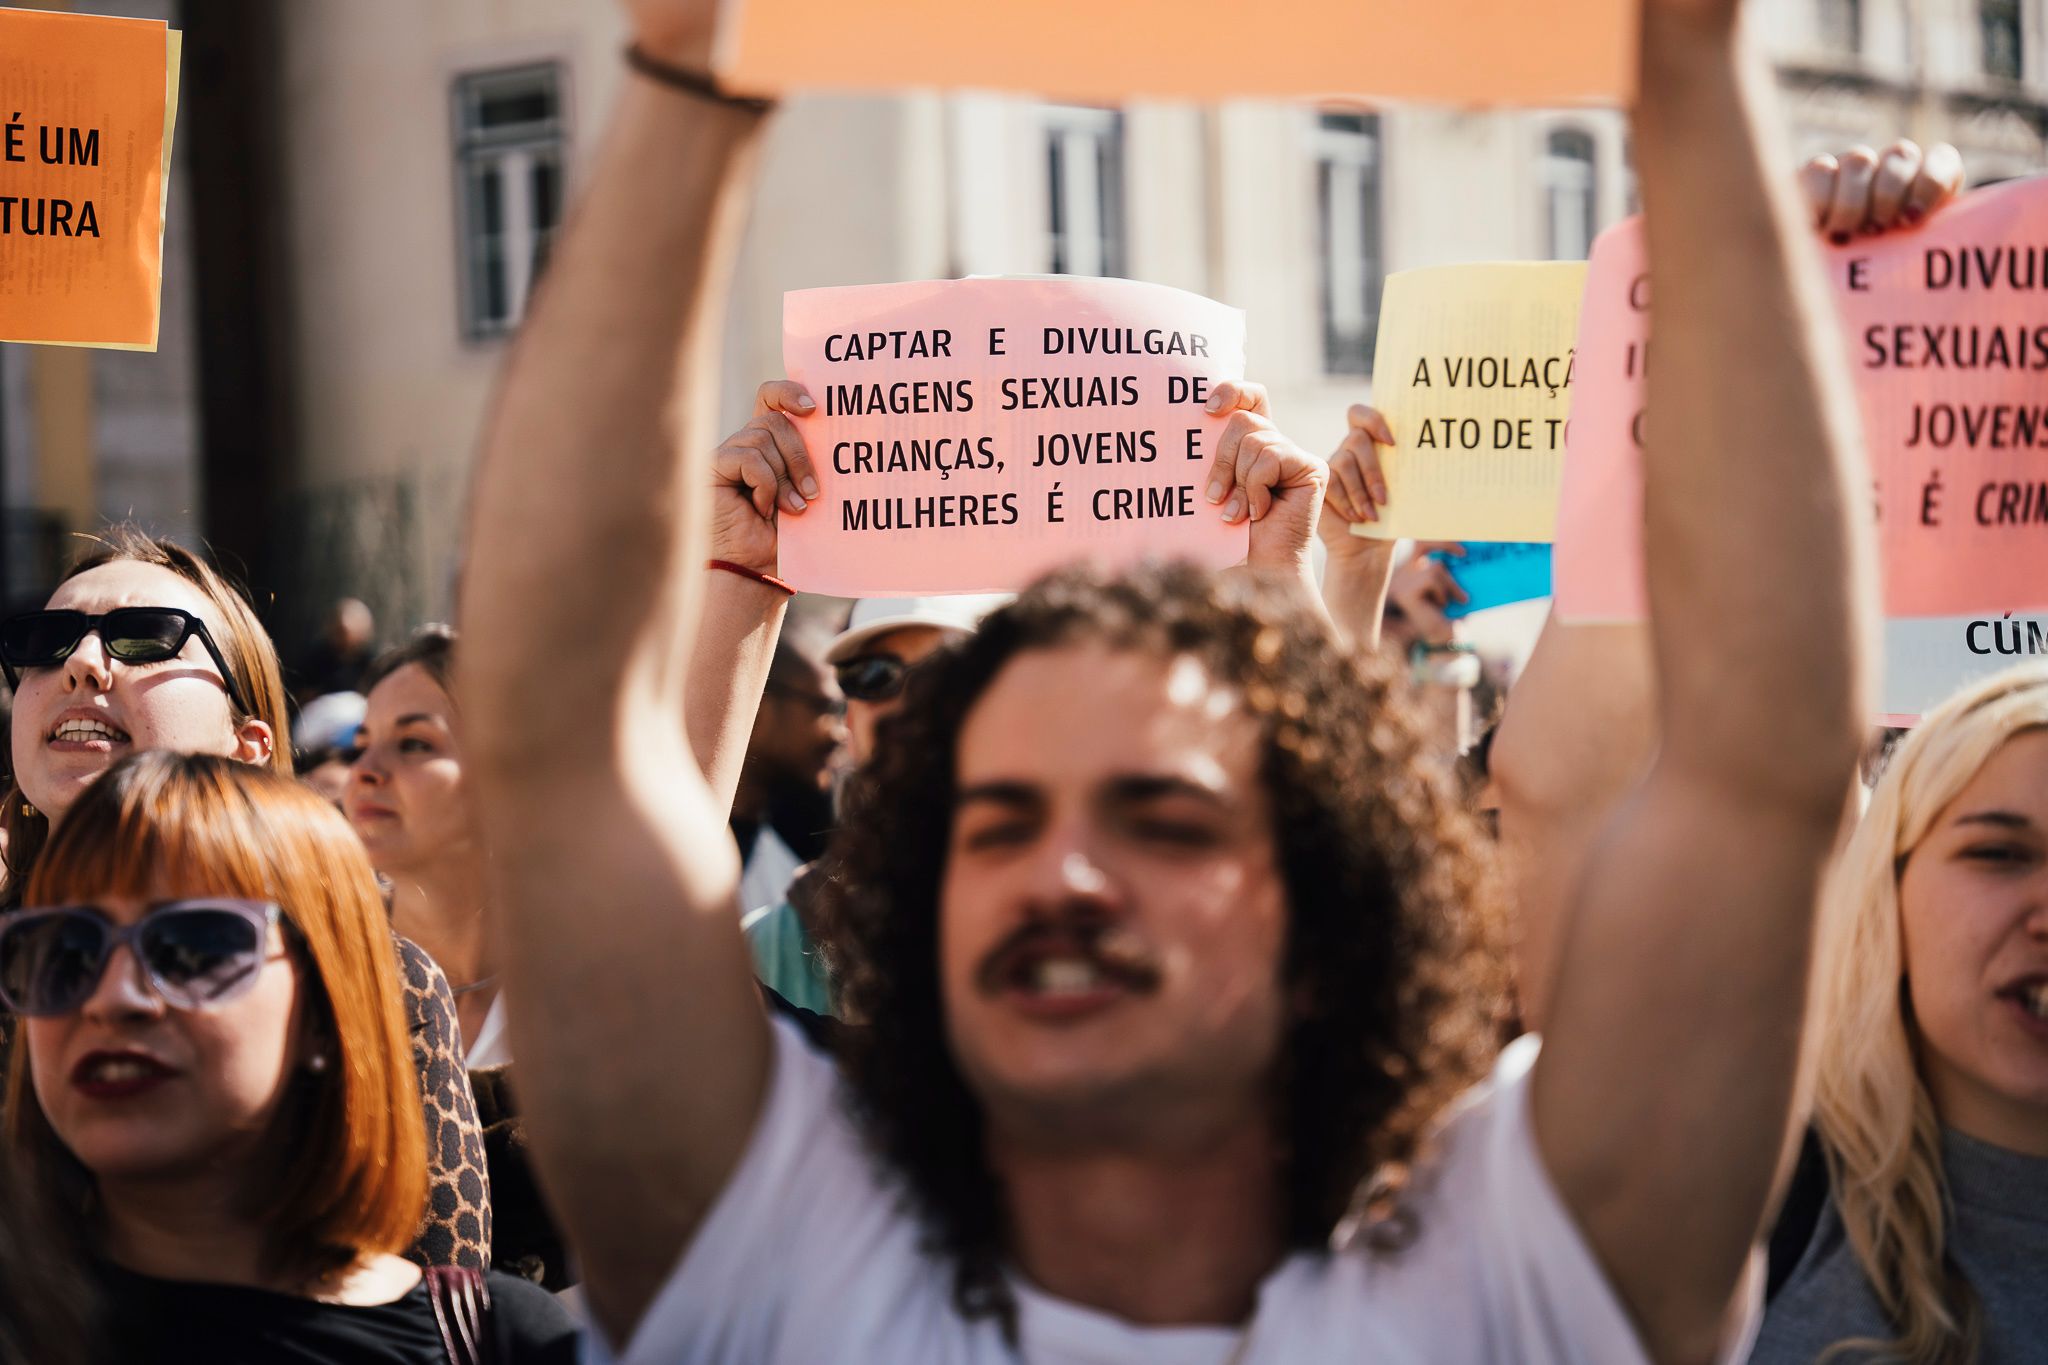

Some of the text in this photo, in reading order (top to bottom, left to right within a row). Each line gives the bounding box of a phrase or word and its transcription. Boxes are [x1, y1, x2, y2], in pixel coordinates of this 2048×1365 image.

[5, 112, 99, 166] É UM
[1848, 258, 1871, 291] E
[825, 327, 1209, 362] CAPTAR E DIVULGAR
[1413, 358, 1431, 387] A
[827, 376, 1207, 416] IMAGENS SEXUAIS DE
[1418, 419, 1480, 449] ATO
[1494, 419, 1532, 449] DE
[833, 429, 1203, 480] CRIANÇAS, JOVENS E
[843, 482, 1194, 530] MULHERES É CRIME
[1920, 468, 1943, 527] É
